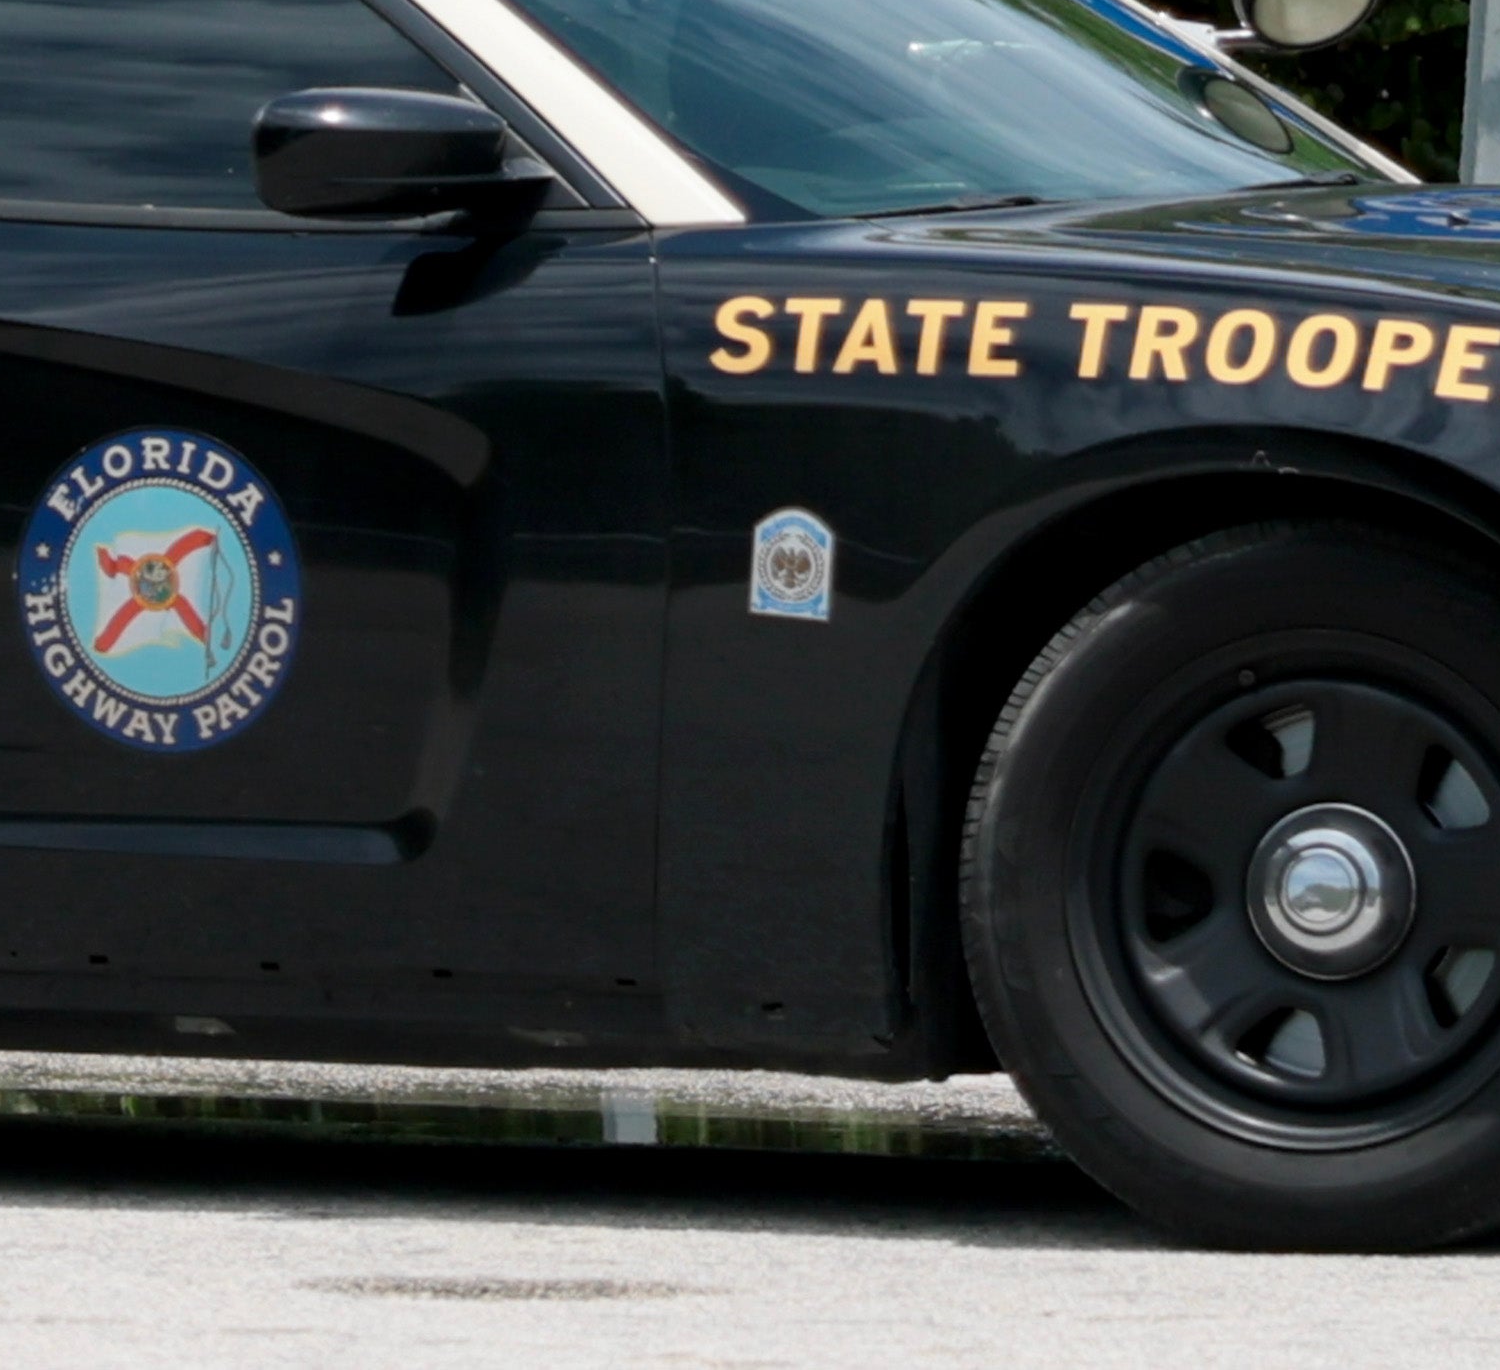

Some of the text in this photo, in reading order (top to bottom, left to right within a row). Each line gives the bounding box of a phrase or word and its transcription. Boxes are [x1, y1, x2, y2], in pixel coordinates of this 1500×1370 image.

[708, 295, 1032, 378] STATE
[47, 436, 265, 526] FLORIDA
[25, 591, 295, 745] HIGHWAY PATROL
